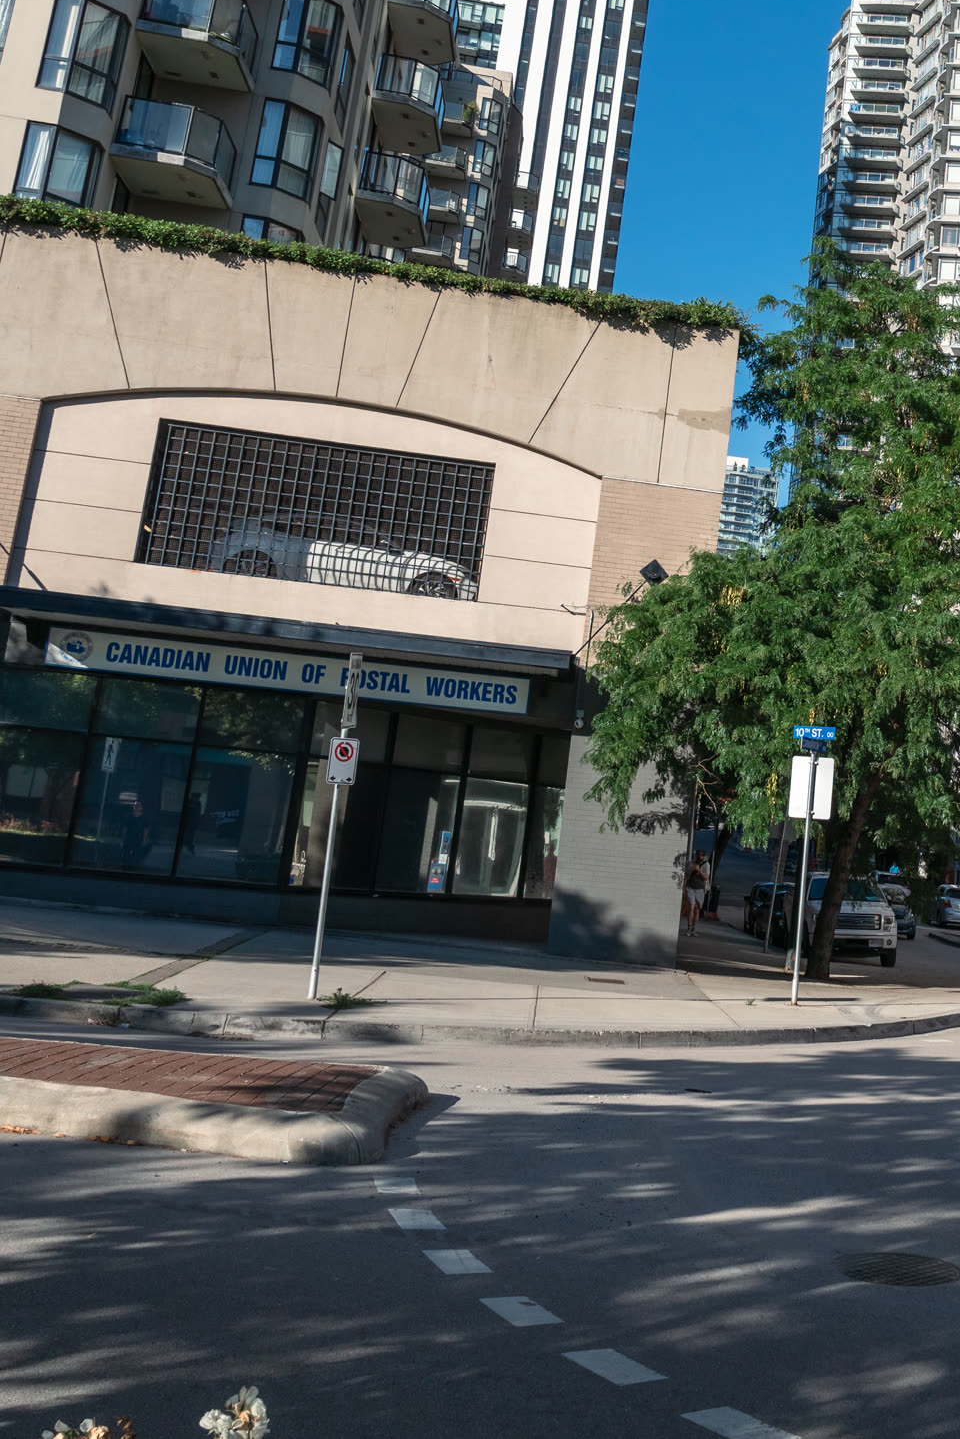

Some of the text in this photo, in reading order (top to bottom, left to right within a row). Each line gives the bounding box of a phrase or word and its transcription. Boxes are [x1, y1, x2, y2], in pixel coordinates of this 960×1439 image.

[105, 641, 211, 672] CANADIAN
[224, 655, 288, 681] UNION
[301, 663, 327, 684] OF
[426, 676, 518, 705] WORKERS
[811, 728, 824, 738] ST.
